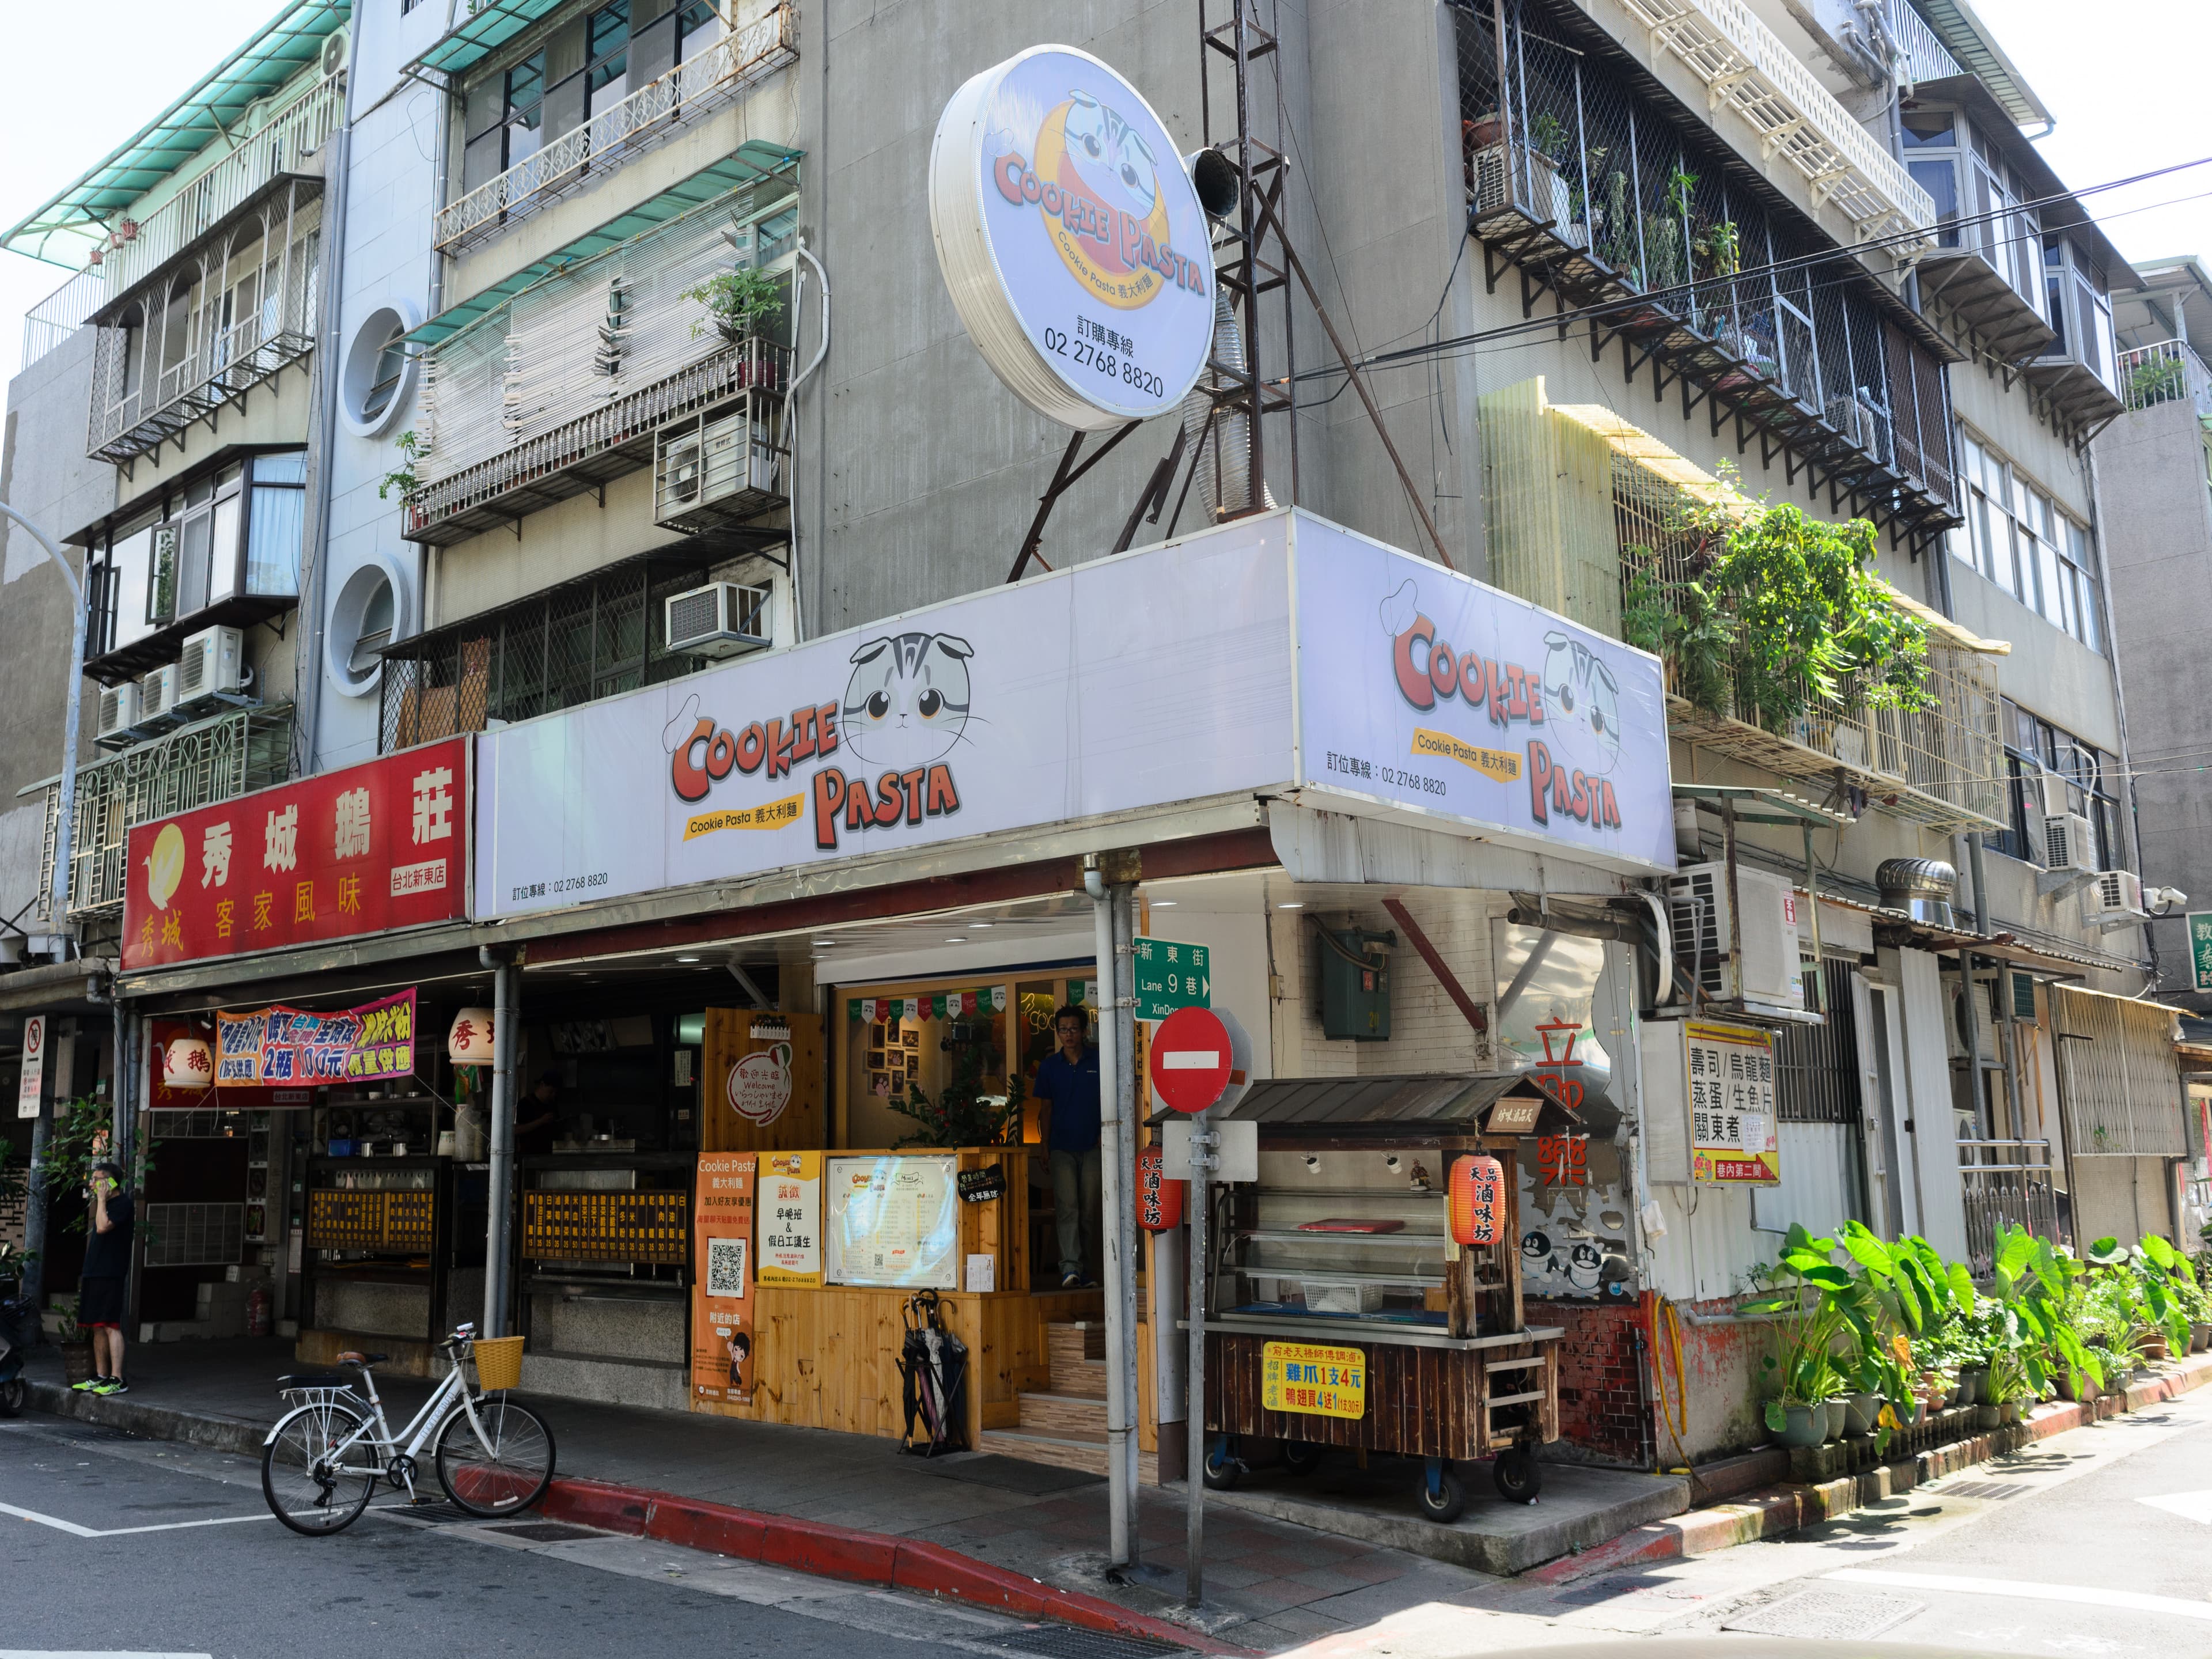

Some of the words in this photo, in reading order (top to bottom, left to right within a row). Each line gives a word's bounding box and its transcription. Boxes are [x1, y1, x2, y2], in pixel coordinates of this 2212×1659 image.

[1058, 230, 1088, 276] Cookie
[1090, 272, 1116, 296] Pasta
[1117, 274, 1154, 300] 義大利麵
[1120, 210, 1205, 297] PASTA
[1077, 315, 1134, 359] 訂購專線
[1044, 327, 1068, 357] 02
[1074, 339, 1116, 377] 2768
[1123, 362, 1163, 398] 8820
[1393, 611, 1544, 728] COOKIE
[672, 699, 839, 803] COOKIE
[1418, 734, 1451, 755] Cookie
[1453, 740, 1478, 763] Pasta
[1480, 751, 1517, 777] 義大利麵
[1397, 771, 1421, 790] 2768
[1423, 776, 1446, 797] 8820
[1527, 740, 1621, 829] PASTA
[690, 815, 724, 834] Cookie
[725, 810, 751, 828] Pasta
[754, 801, 798, 825] 義大利麵
[812, 762, 961, 852] PASTA
[201, 766, 453, 889] 秀城鵝莊
[392, 865, 445, 892] 台北新東店
[566, 876, 585, 891] 2768
[587, 873, 608, 888] 8820
[216, 872, 361, 938] 客家風味
[1141, 942, 1203, 967] 新東街
[1142, 979, 1162, 992] Lane
[1168, 974, 1177, 993] 9
[1185, 976, 1196, 995] 巷
[740, 1069, 779, 1081] 歡迎光臨
[1694, 1113, 1740, 1143] 關東煮
[699, 1159, 729, 1172] Cookie
[1469, 1167, 1498, 1182] 天品
[1717, 1163, 1762, 1177] 巷內第二間
[712, 1177, 743, 1189] 義大利麵
[778, 1185, 801, 1199] 誠徵
[704, 1196, 751, 1206] 加入好友享優惠
[1143, 1172, 1162, 1225] 滷味坊
[777, 1208, 802, 1220] 早晚班
[786, 1222, 792, 1232] &
[1474, 1184, 1495, 1243] 滷味坊
[768, 1236, 811, 1248] 假日工讀生
[710, 1312, 740, 1325] 附近的店
